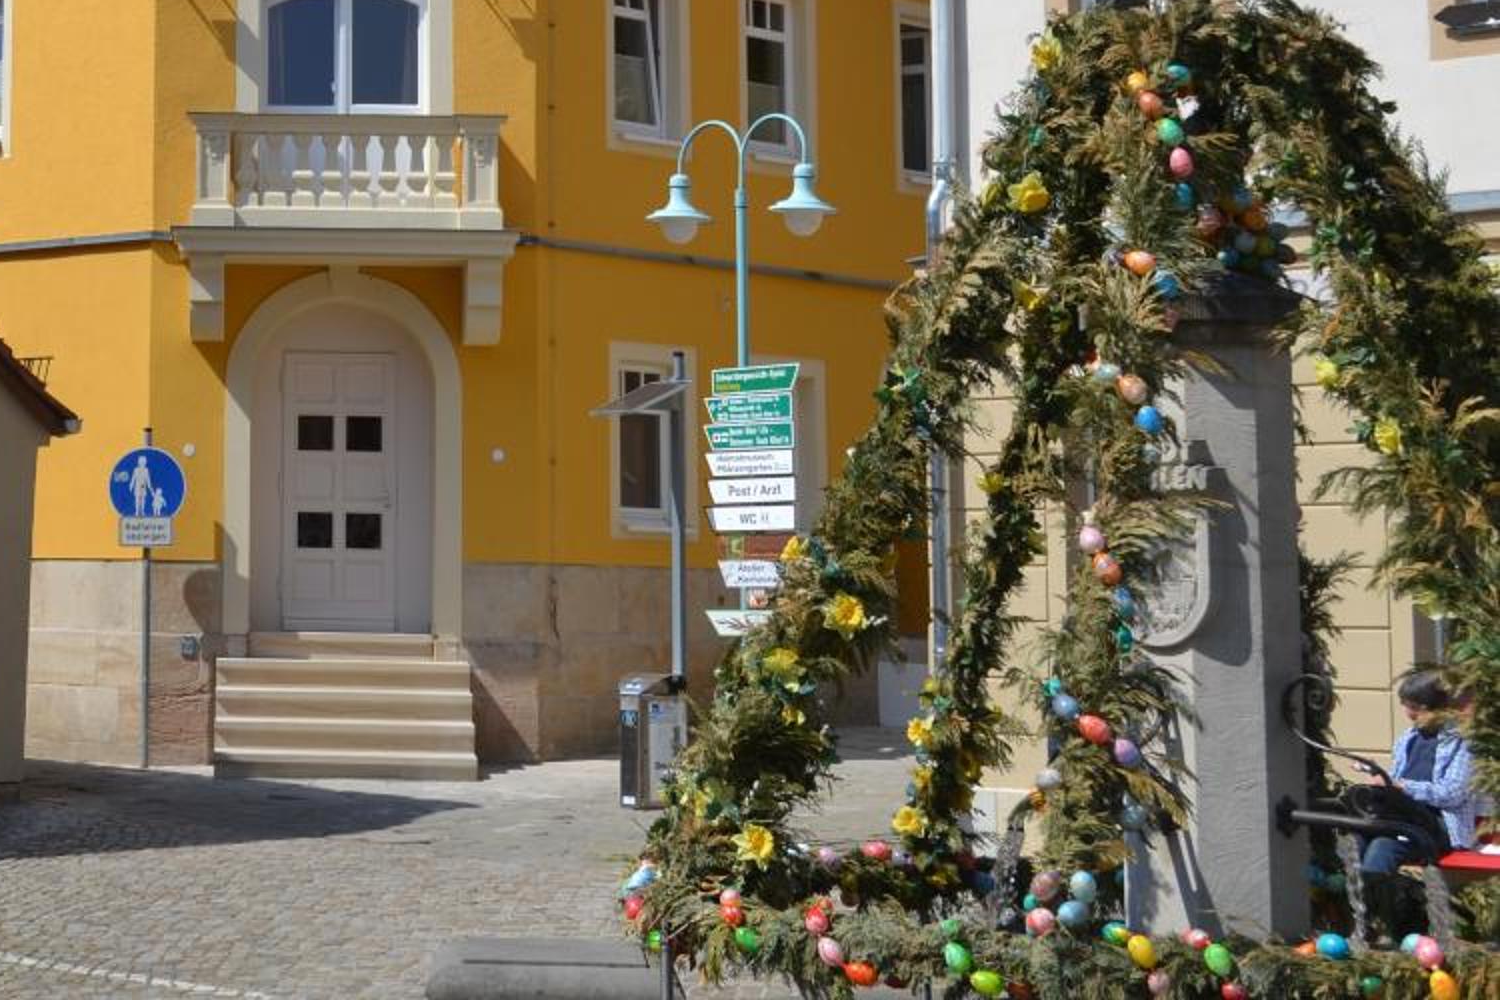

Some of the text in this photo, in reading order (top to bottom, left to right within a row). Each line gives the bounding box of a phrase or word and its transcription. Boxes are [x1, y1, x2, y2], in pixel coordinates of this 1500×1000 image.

[728, 485, 751, 497] Post
[759, 484, 782, 495] Arzt
[739, 513, 757, 525] WC
